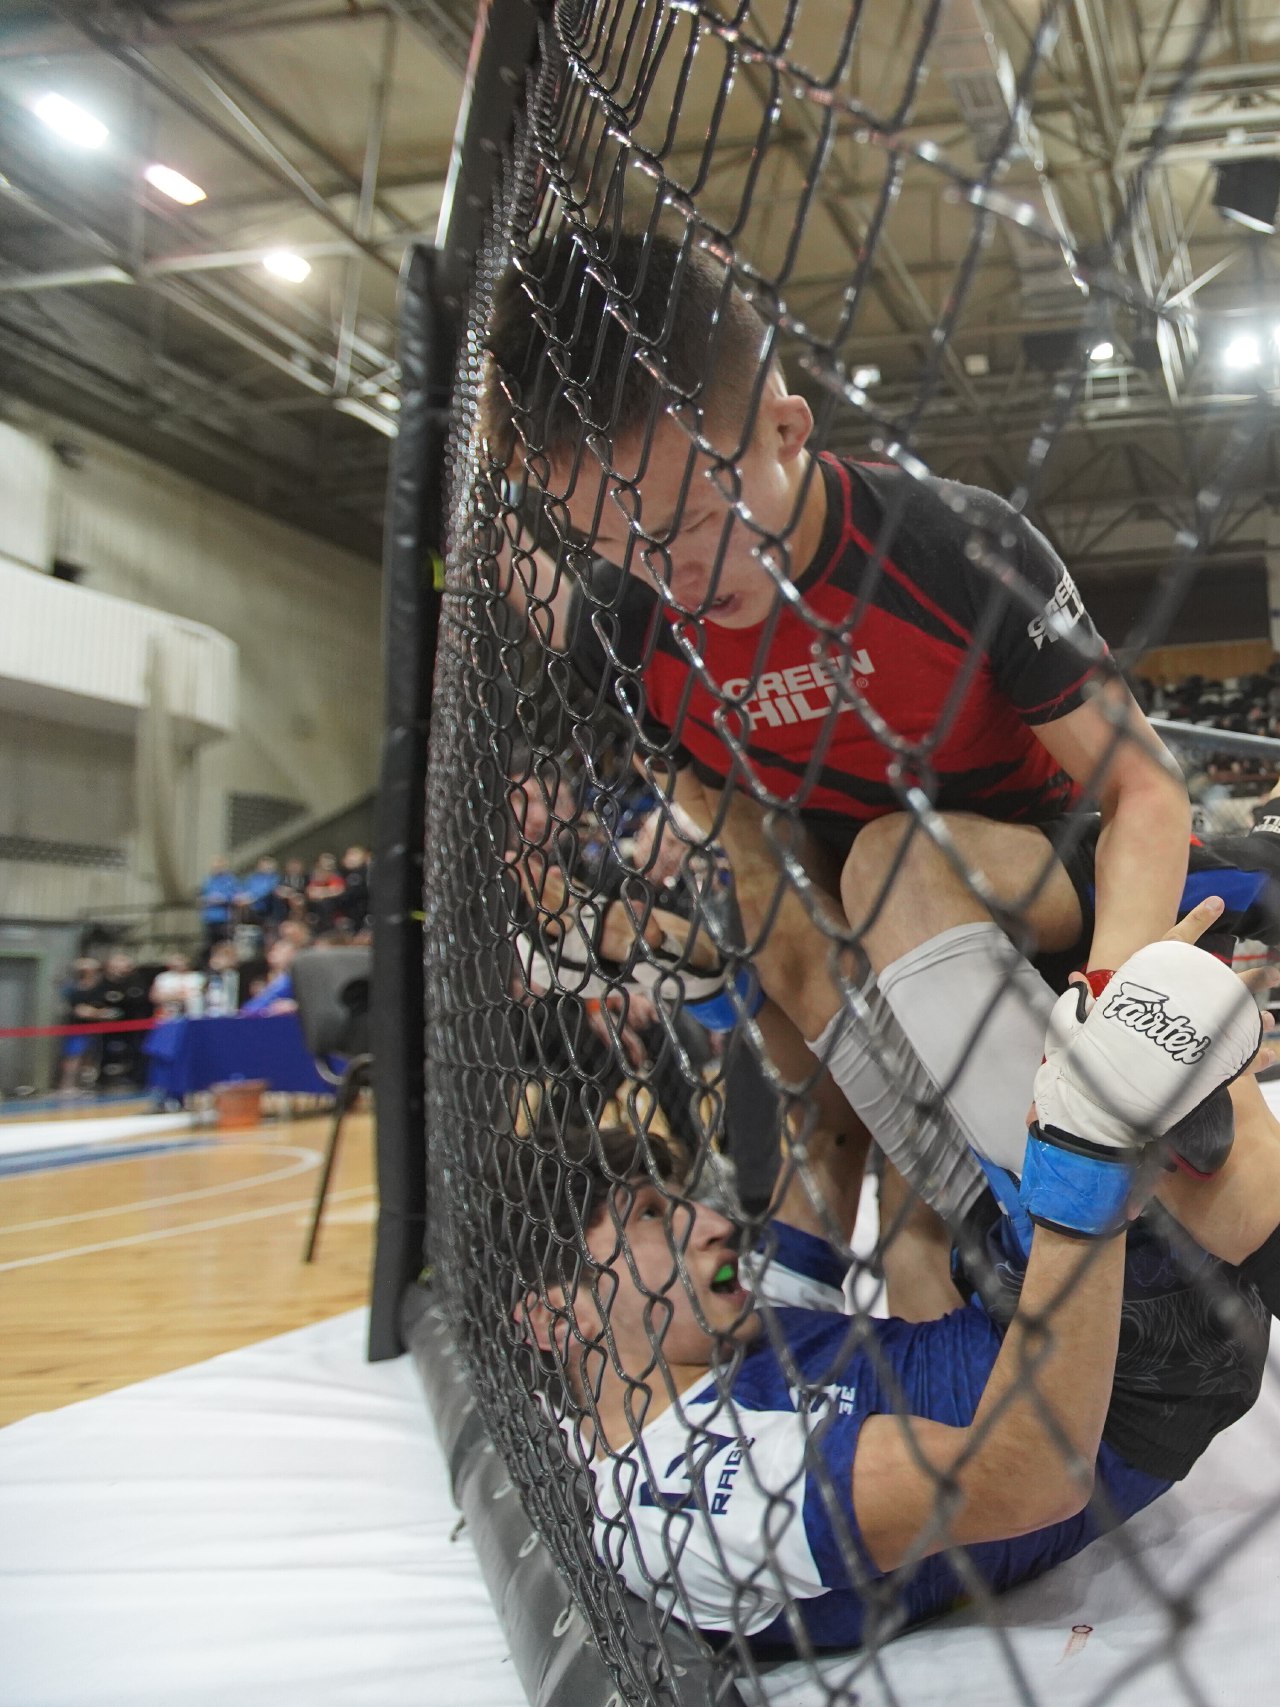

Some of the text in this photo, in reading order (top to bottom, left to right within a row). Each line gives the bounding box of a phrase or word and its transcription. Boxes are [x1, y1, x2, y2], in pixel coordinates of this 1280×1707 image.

[722, 649, 875, 701] GREEN
[743, 685, 871, 731] HILL
[1103, 982, 1211, 1064] Fairtex
